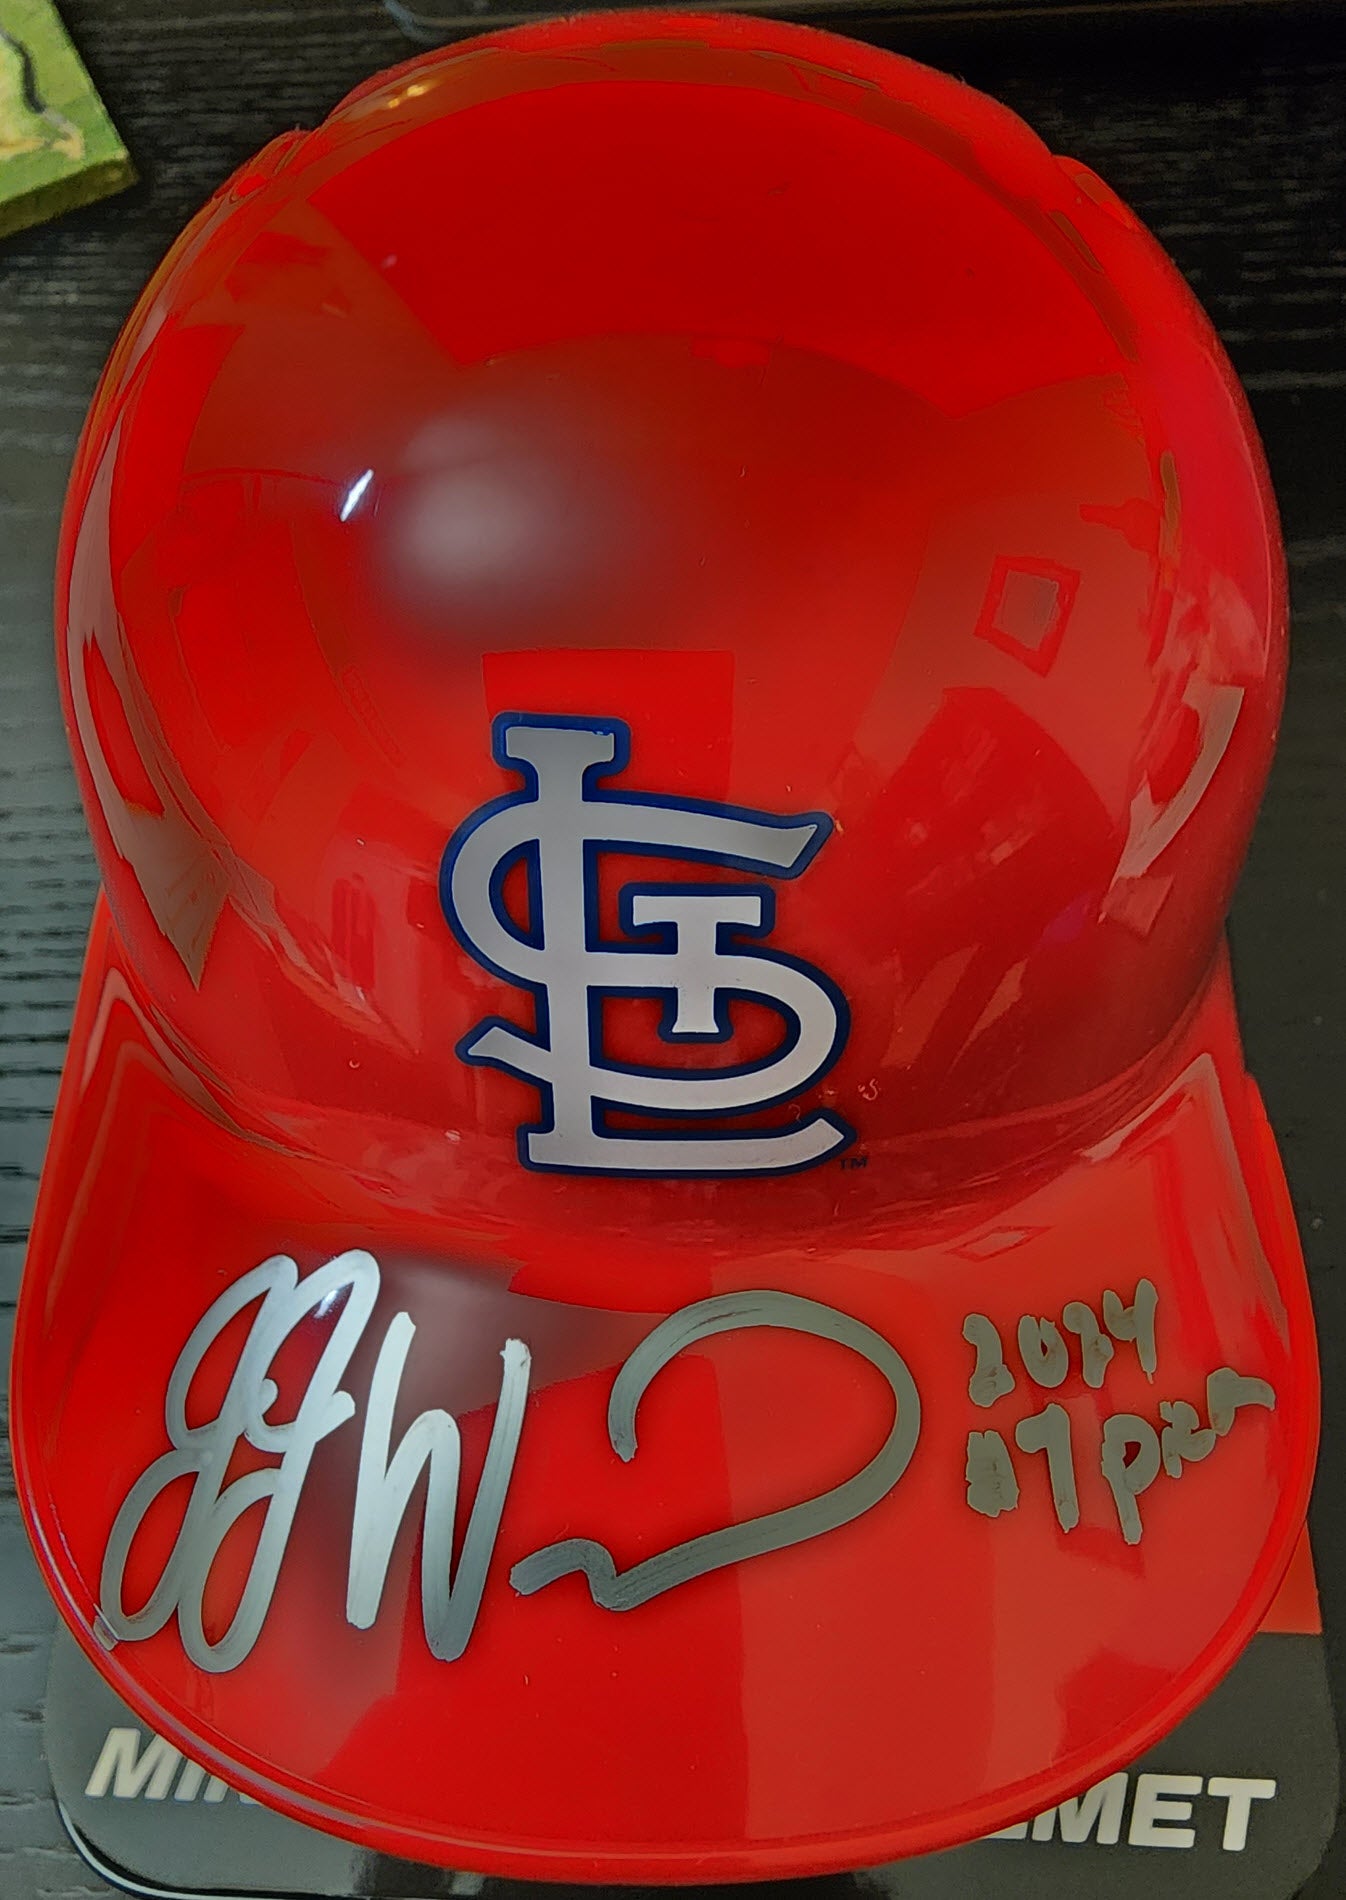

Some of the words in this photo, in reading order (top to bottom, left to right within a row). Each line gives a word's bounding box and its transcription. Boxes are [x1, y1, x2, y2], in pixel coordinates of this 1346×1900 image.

[840, 1156, 868, 1169] TM
[85, 1727, 262, 1805] MI
[985, 1772, 1277, 1852] MET
